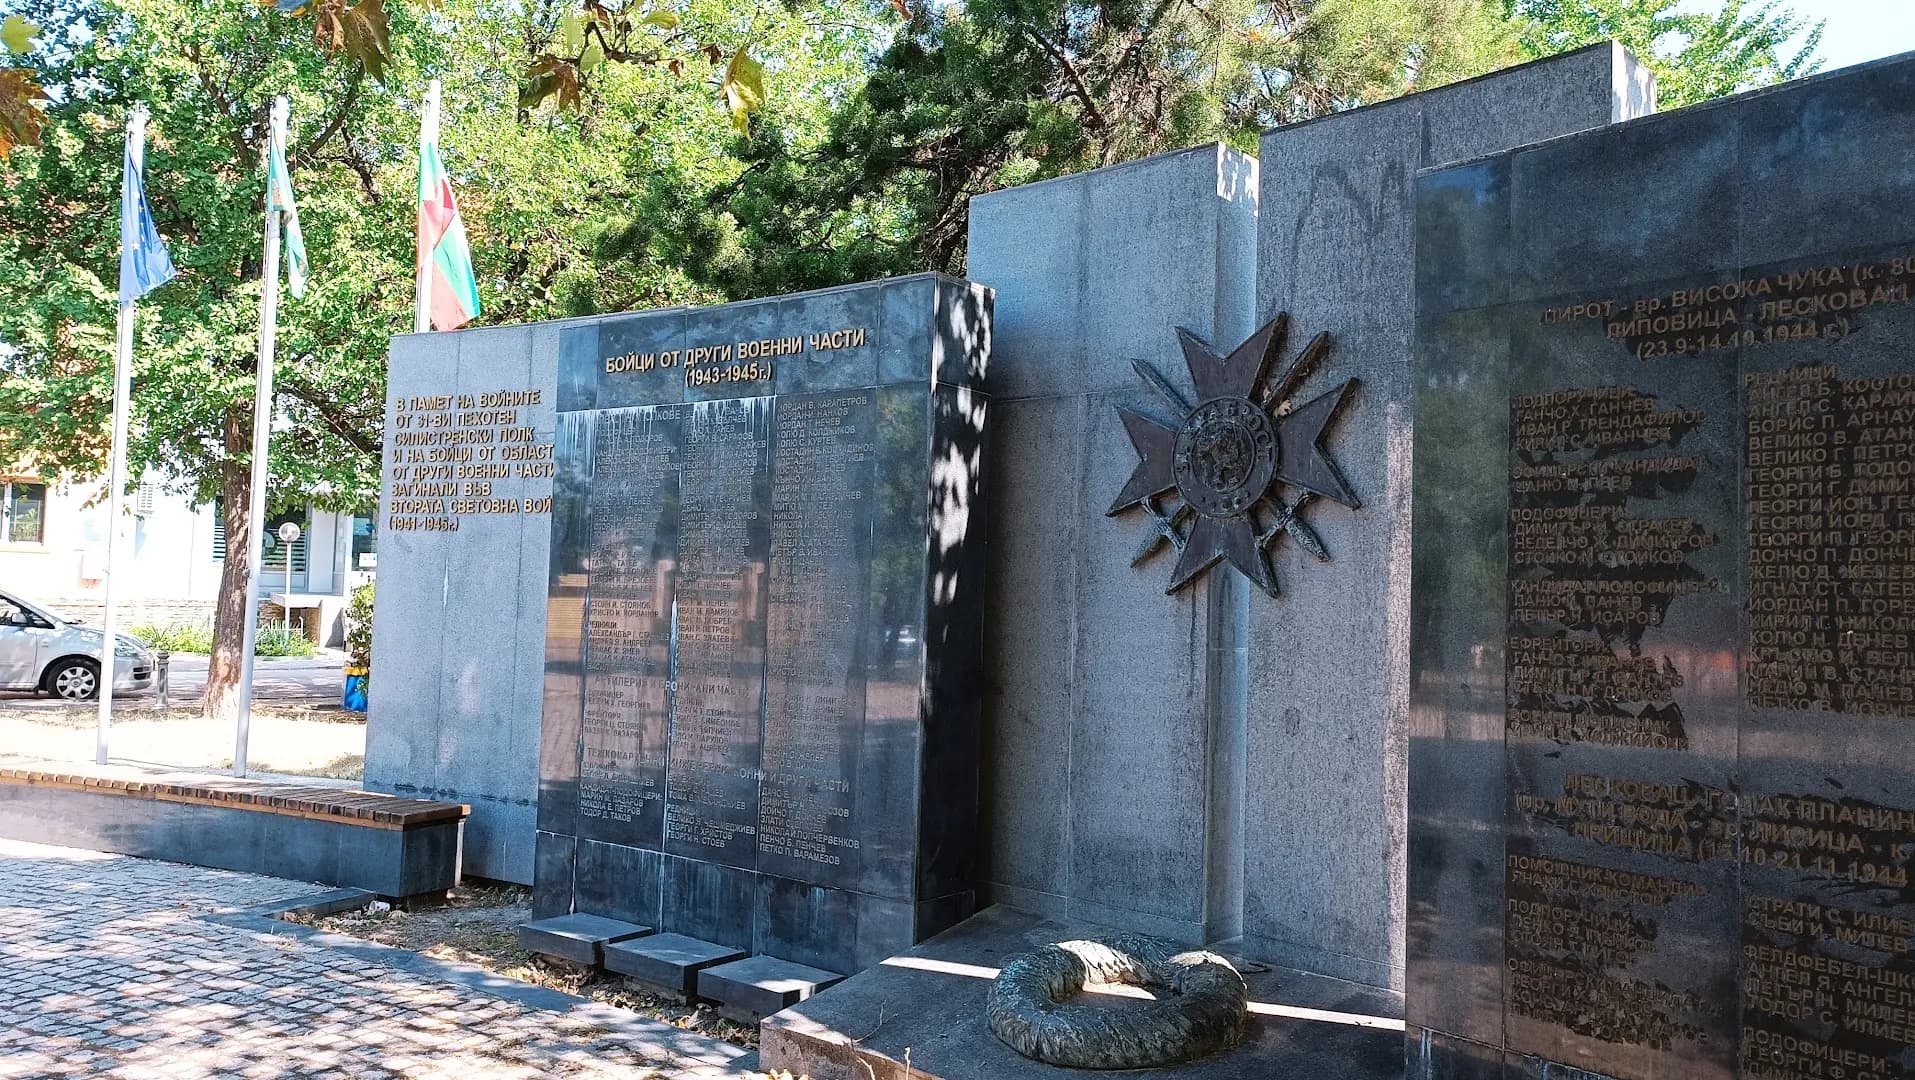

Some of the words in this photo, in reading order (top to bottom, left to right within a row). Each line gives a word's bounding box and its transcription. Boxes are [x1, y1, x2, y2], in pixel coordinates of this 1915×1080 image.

[1545, 300, 1613, 323] ПИРОТ
[1671, 277, 1771, 307] ВИСОКА
[1778, 267, 1844, 291] ЧУКА
[1607, 306, 1737, 339] ЛИПОВИЦА
[1760, 283, 1908, 321] ЛЕСКОВАЦ
[606, 352, 655, 373] БОЙЦИ
[660, 351, 682, 368] ОТ
[684, 345, 732, 369] ДРУГИ
[738, 336, 802, 359] ВОЕННИ
[810, 329, 865, 351] ЧАСТИ
[396, 398, 405, 411] В
[410, 395, 452, 411] ПАМЕТ
[458, 394, 473, 409] НА
[479, 390, 540, 407] ВОЙНИТЕ
[1590, 398, 1656, 415] ГАНЧЕВ
[1749, 399, 1810, 418] АНГЕЛ
[1843, 392, 1915, 410] КАРАИ
[395, 415, 412, 428] ОТ
[418, 413, 451, 427] 31-ВИ
[458, 410, 516, 426] ПЕХОТЕН
[1749, 417, 1814, 433] БОРИС
[395, 429, 493, 446] СИЛИСТРЕНСКИ
[500, 427, 534, 442] ПОЛК
[1749, 432, 1827, 450] ВЕЛИКО
[394, 450, 401, 463] И
[407, 449, 423, 462] НА
[429, 444, 472, 463] БОЙЦИ
[478, 446, 496, 460] ОТ
[502, 444, 554, 460] ОБЛАСТ
[1749, 448, 1827, 466] ВЕЛИКО
[393, 468, 409, 479] ОТ
[413, 466, 453, 481] ДРУГИ
[457, 465, 509, 478] ВОЕННИ
[1749, 466, 1823, 481] ГЕОРГИ
[1854, 460, 1915, 477] ТОДО
[391, 483, 457, 496] ЗАГИНАЛИ
[464, 481, 491, 496] ВЪВ
[1749, 482, 1823, 497] ГЕОРГИ
[390, 500, 444, 513] ВТОРАТА
[450, 499, 519, 513] СВЕТОВНА
[524, 495, 552, 513] ВОЙ
[1749, 498, 1823, 513] ГЕОРГИ
[1749, 515, 1823, 530] ГЕОРГИ
[1749, 532, 1821, 547] ГЕОРГИ
[1749, 548, 1817, 564] ДОНЧО
[1749, 565, 1810, 579] ЖЕЛЮ
[1843, 564, 1915, 579] ЖЕЛЕВ
[1749, 581, 1808, 595] ИГНАТ
[1851, 581, 1915, 596] ГАТЕВ
[1749, 614, 1812, 632] КИРИЛ
[1749, 630, 1806, 645] КОЛЮ
[581, 808, 601, 817] ТОДОР
[611, 812, 631, 822] ТАКОВ
[615, 804, 640, 815] ПЕТРОВ
[701, 827, 733, 840] ХРИСТОВ
[702, 836, 726, 848] СТОЕВ
[759, 842, 784, 854] ПЕТКО
[794, 850, 840, 865] ВАРАМЕЗОВ
[1854, 911, 1915, 935] ИЛИЕ
[1744, 944, 1915, 989] ФЕЛДФЕБЕЛ-ШК
[1841, 980, 1915, 1007] АНГЕЛ
[1746, 992, 1813, 1019] ТОДОР
